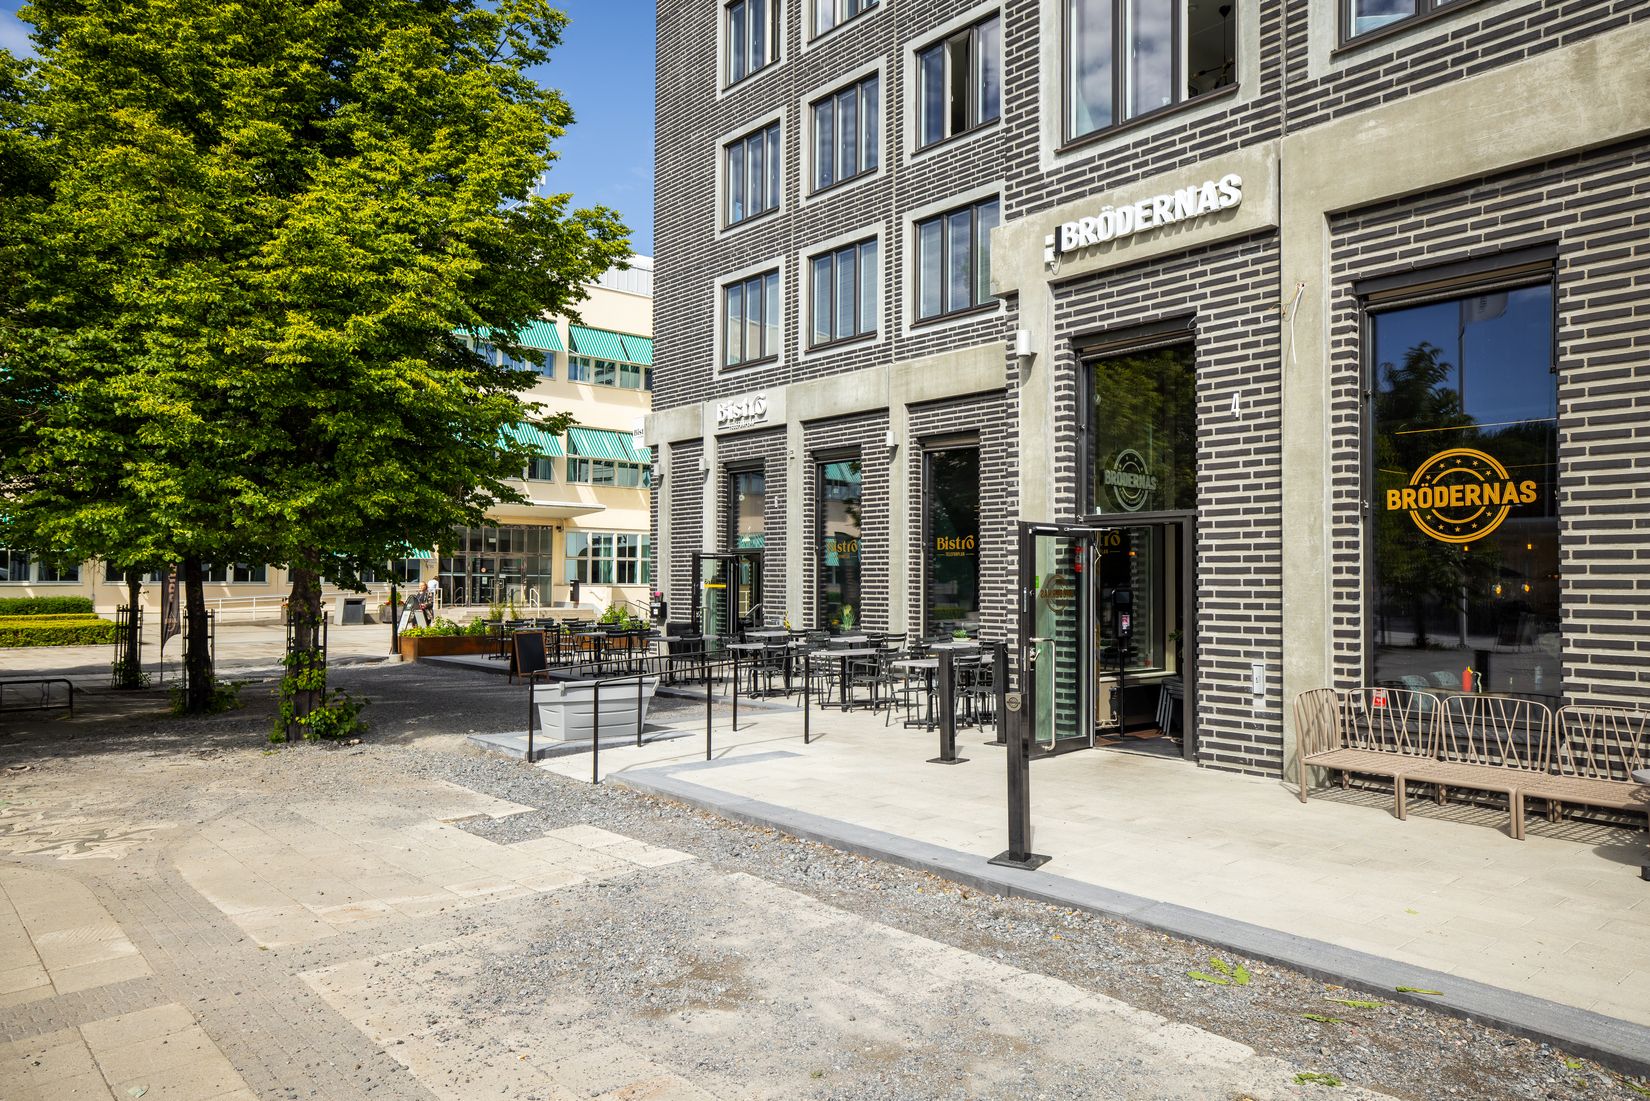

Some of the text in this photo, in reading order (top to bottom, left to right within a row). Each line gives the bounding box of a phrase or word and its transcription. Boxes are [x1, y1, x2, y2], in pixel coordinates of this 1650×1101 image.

[1062, 173, 1243, 252] BRÖDERNAS
[1231, 393, 1240, 418] 4
[1387, 480, 1537, 510] BRÖDERNAS
